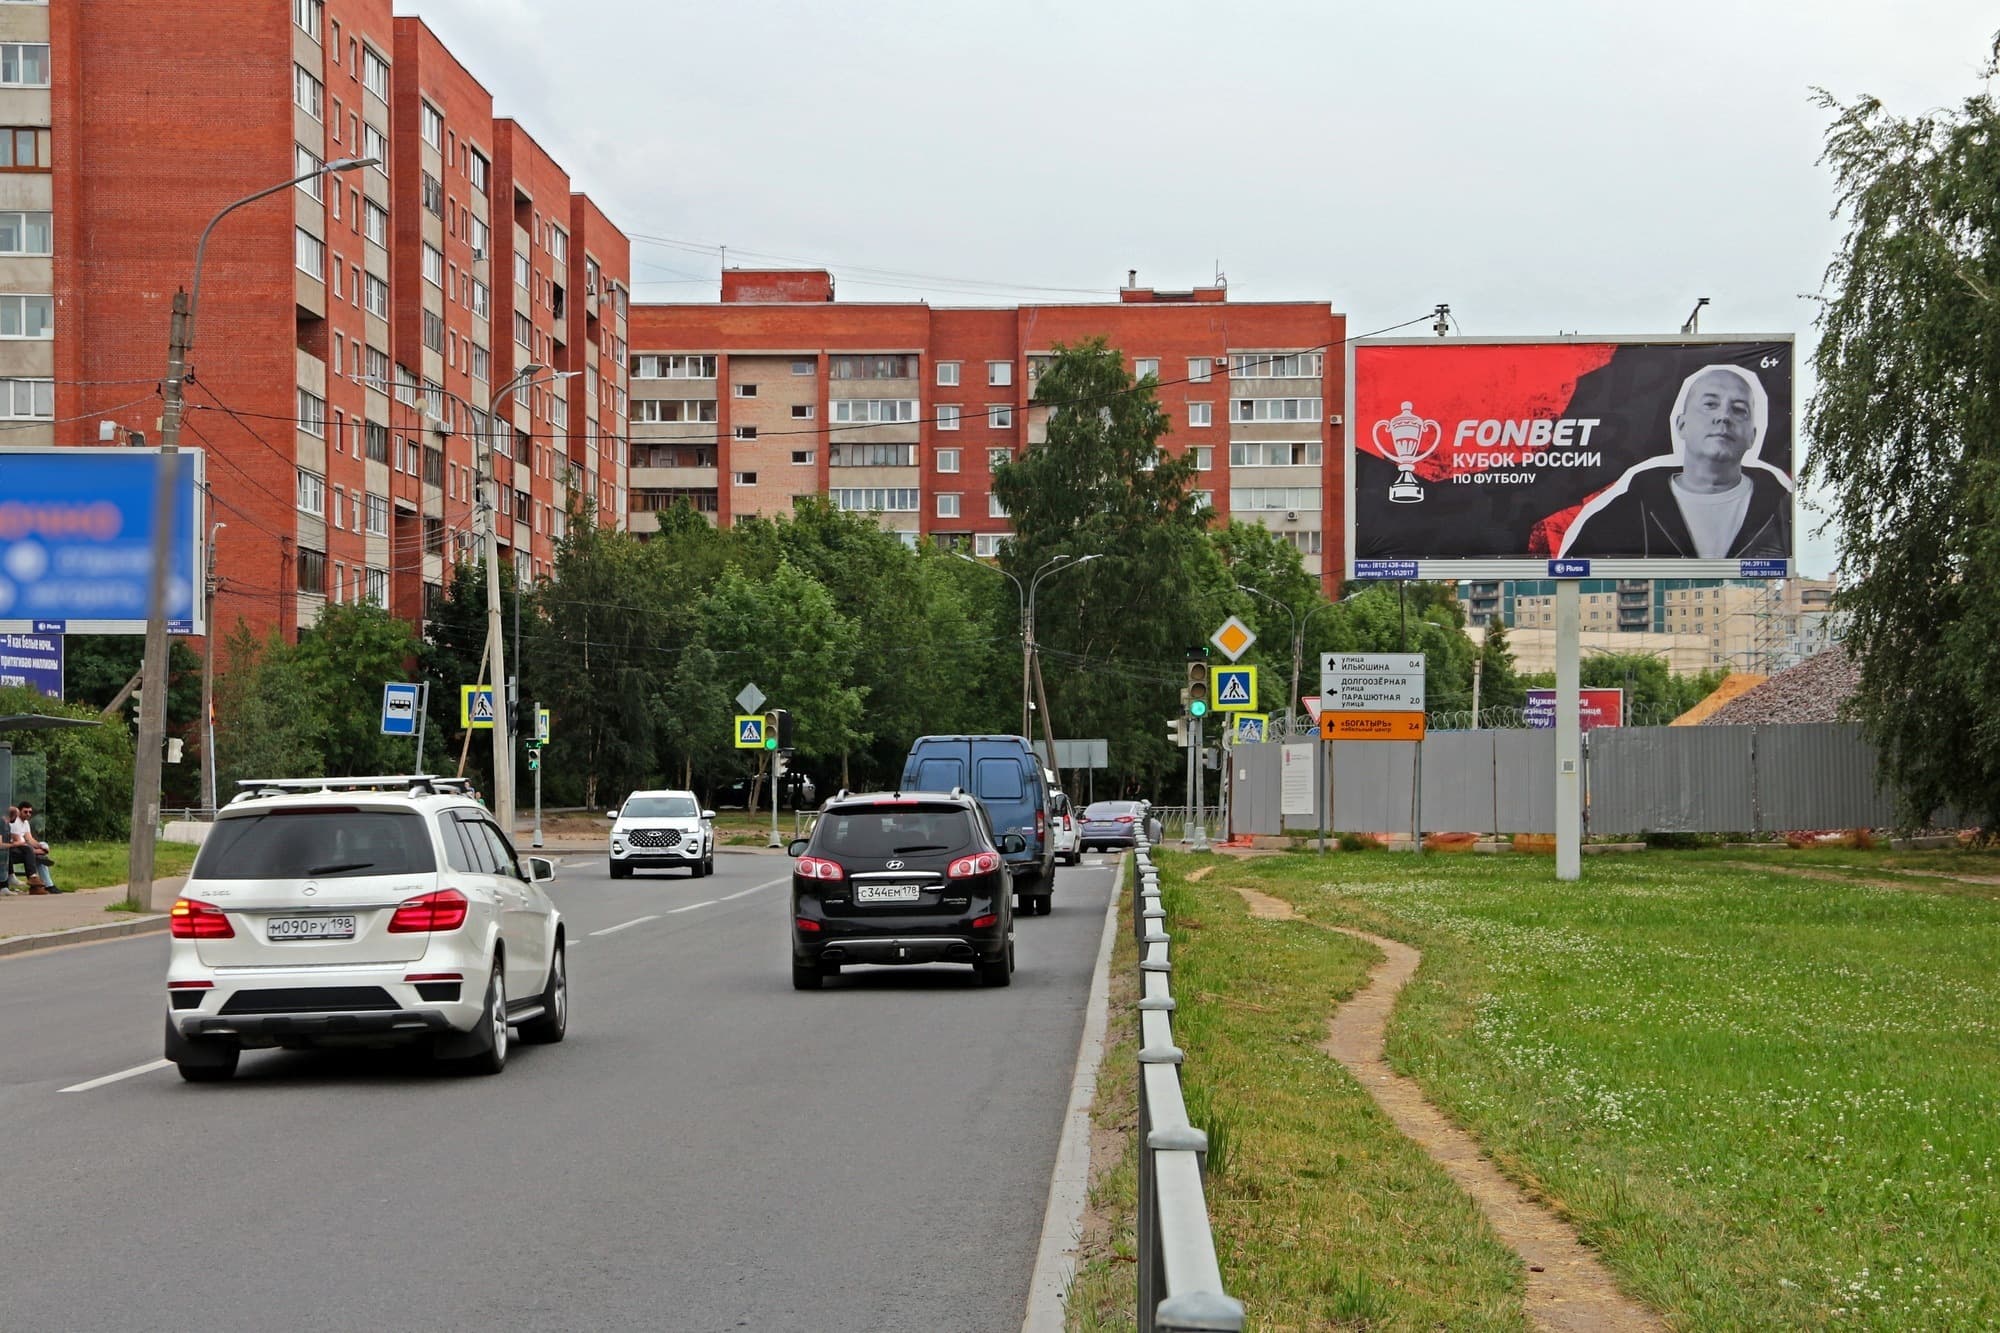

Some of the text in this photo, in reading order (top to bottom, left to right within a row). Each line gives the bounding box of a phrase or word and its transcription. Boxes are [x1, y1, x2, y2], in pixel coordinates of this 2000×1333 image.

[1760, 356, 1779, 368] 6+
[1453, 418, 1601, 447] FONBET
[1453, 452, 1601, 468] КУБОК РОССИИ
[1453, 472, 1536, 484] ПО ФУТБОЛУ
[1341, 677, 1407, 686] ДОЛГООЗЁРНАЯ
[861, 888, 901, 897] С344ЕМ
[270, 918, 351, 934] М090РУ 198
